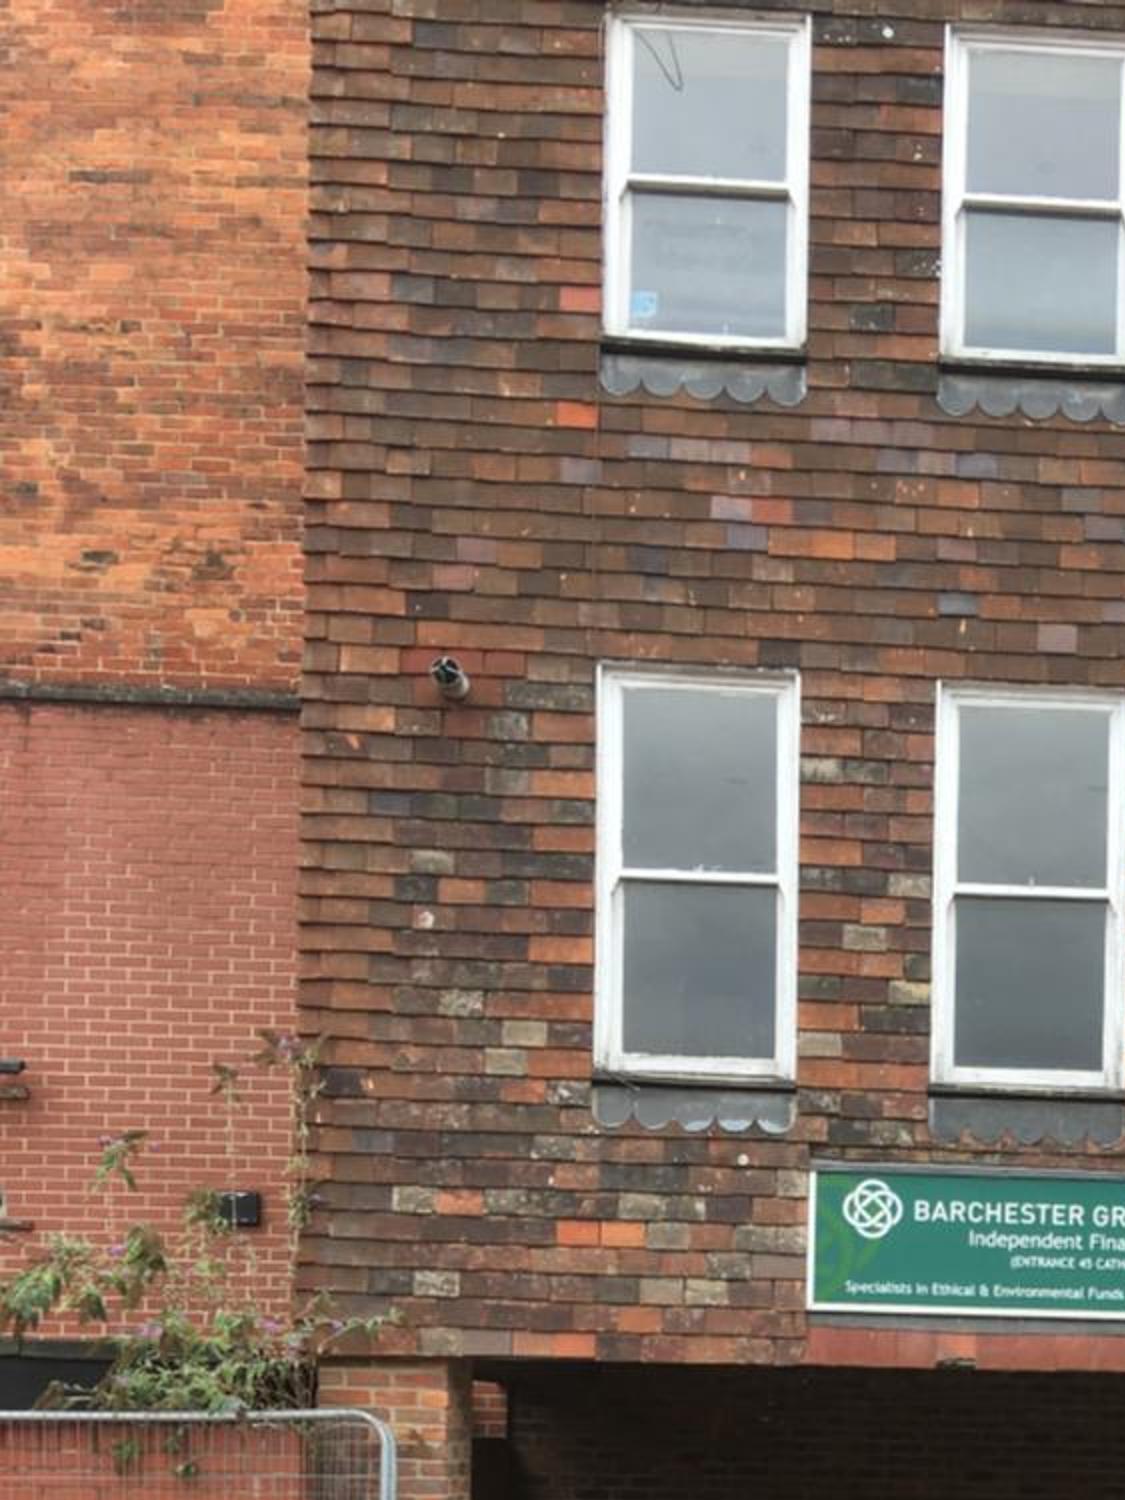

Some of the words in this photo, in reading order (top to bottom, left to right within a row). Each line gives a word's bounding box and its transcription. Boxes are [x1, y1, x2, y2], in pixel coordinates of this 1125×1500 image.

[914, 1199, 1084, 1225] BARCHESTER
[969, 1230, 1082, 1250] Independent
[1010, 1255, 1074, 1269] (ENTRANCE
[845, 1280, 911, 1295] Specialists
[932, 1282, 976, 1295] Ethical
[979, 1284, 989, 1296] &
[993, 1284, 1083, 1298] Environmental
[1088, 1287, 1124, 1299] Funds
